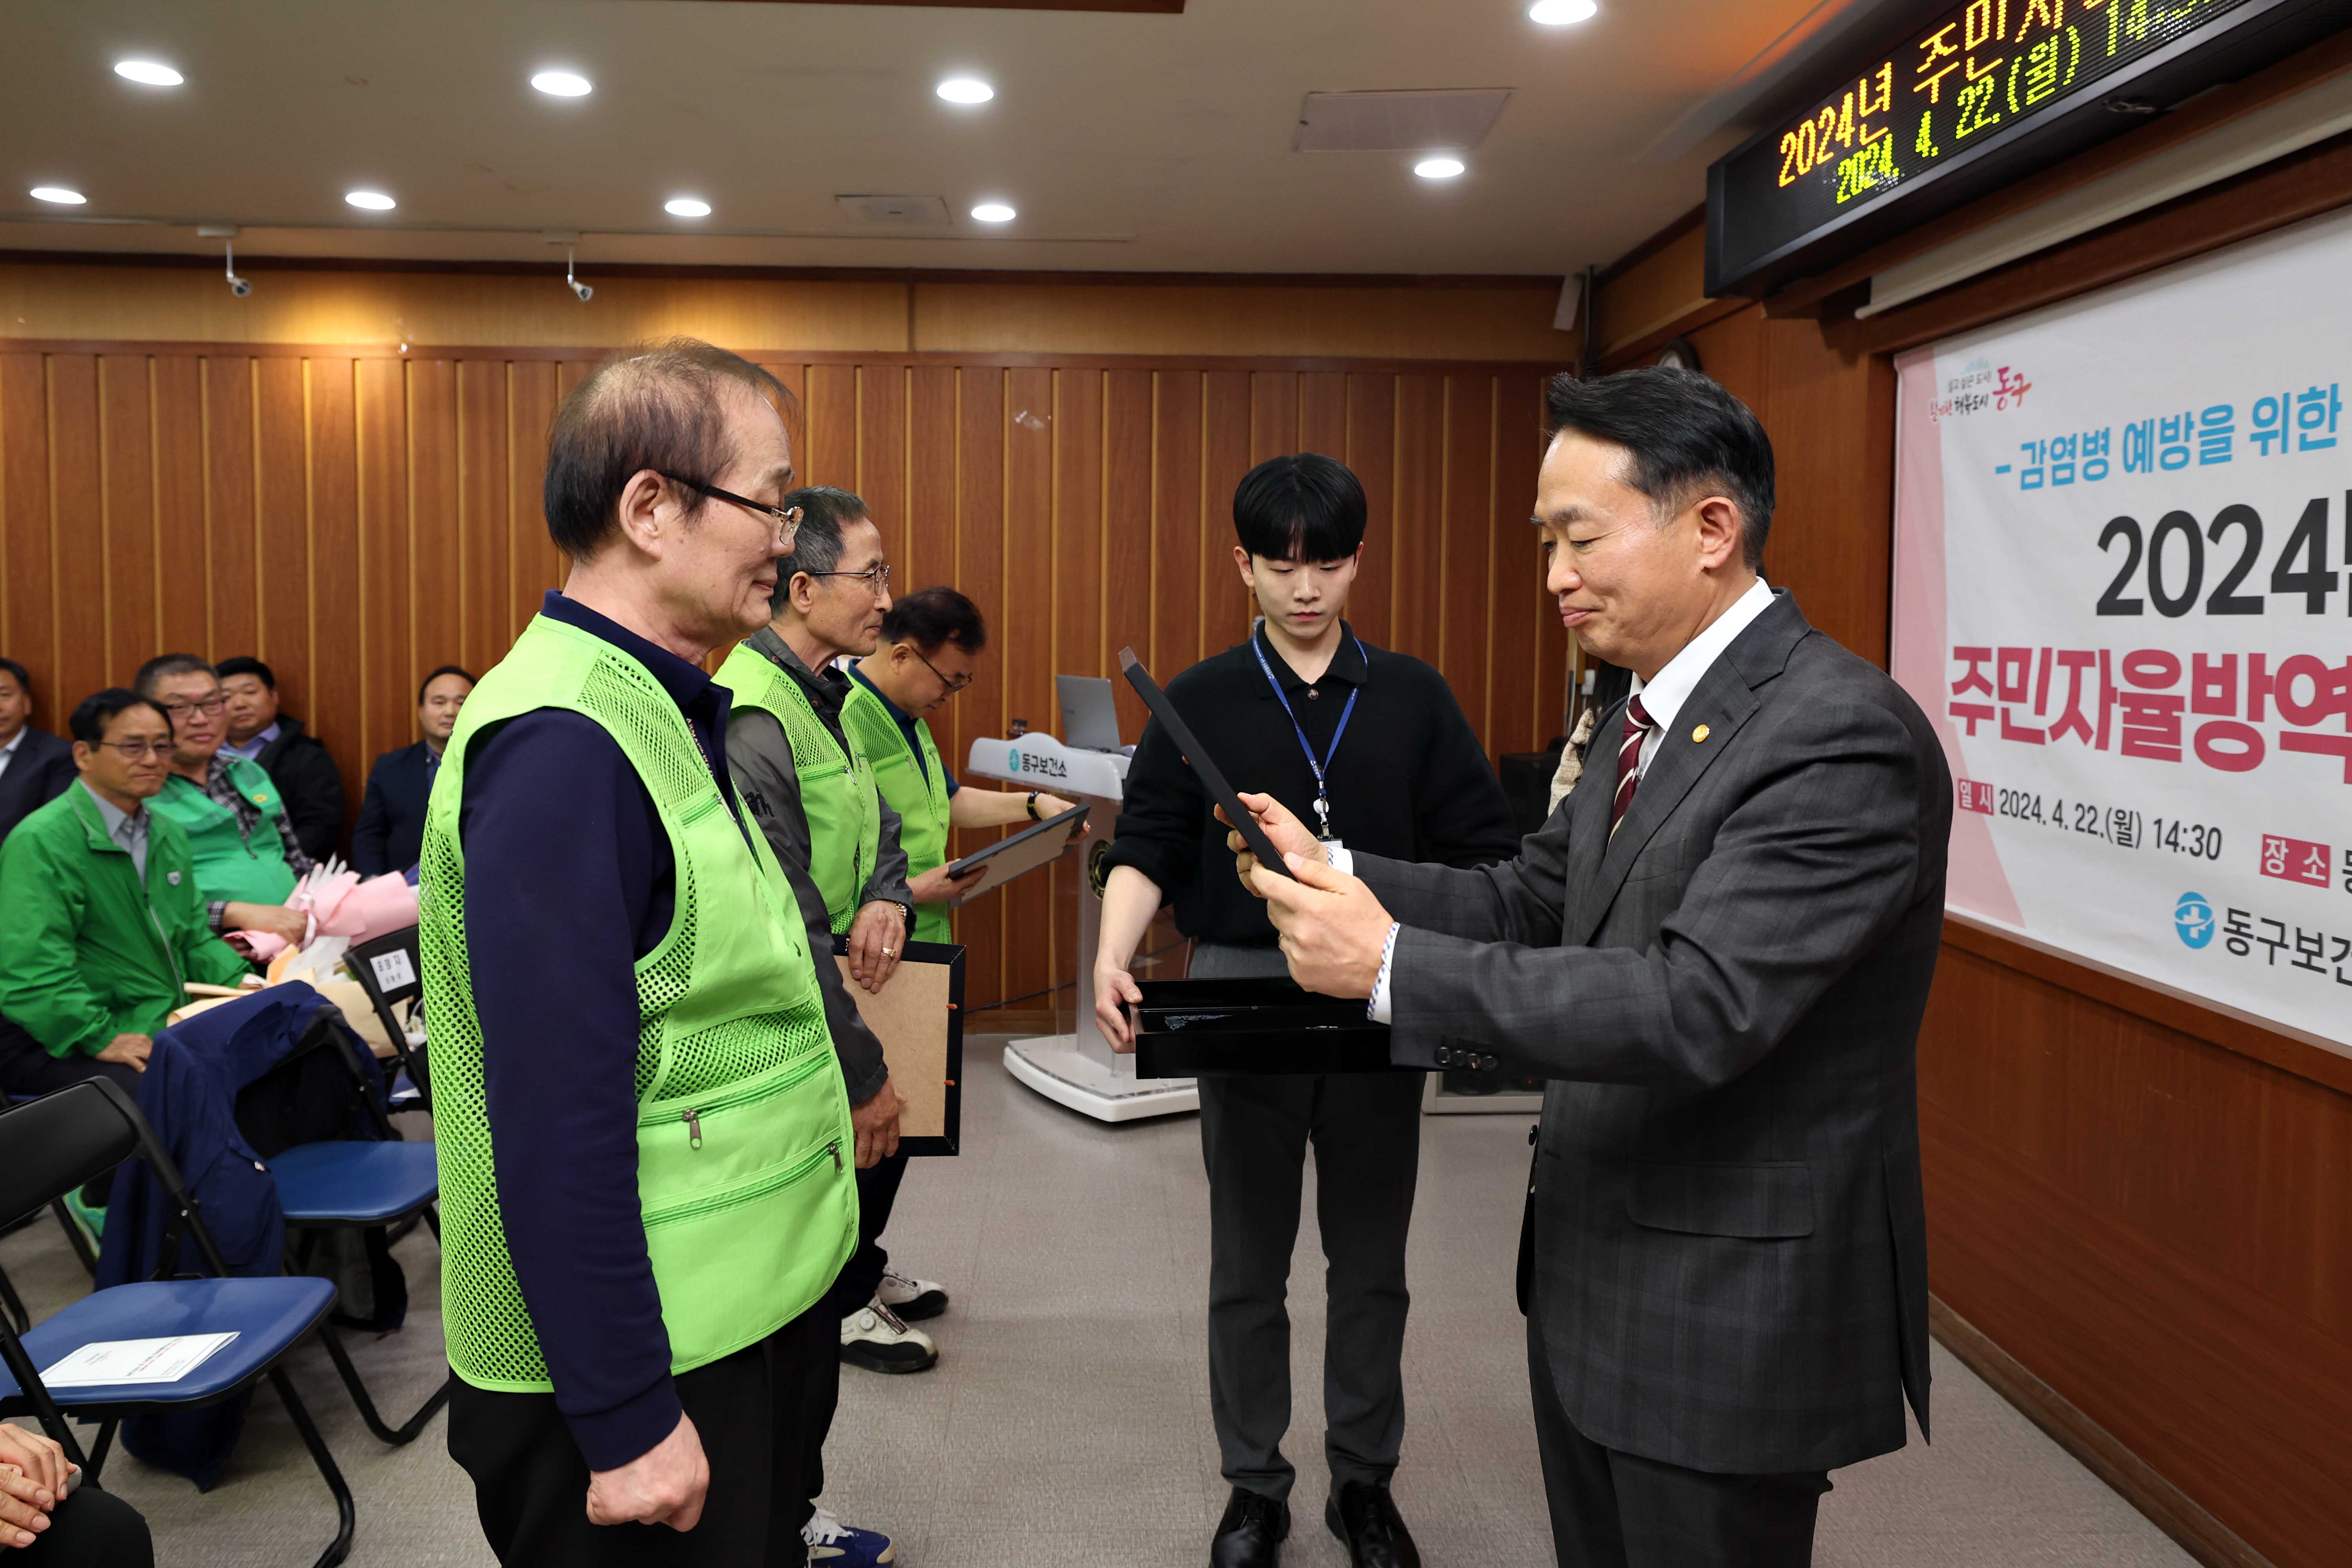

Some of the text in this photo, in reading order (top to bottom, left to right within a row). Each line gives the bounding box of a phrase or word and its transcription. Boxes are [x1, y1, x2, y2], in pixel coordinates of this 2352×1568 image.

[1779, 62, 1892, 187] 2024년
[1837, 133, 1899, 203] 2024.
[1915, 111, 1938, 157] 4.
[1993, 366, 2032, 411] 동구
[2123, 405, 2235, 473] 예방을
[2250, 383, 2342, 457] 위한
[2096, 489, 2352, 618] 2024
[1949, 646, 2352, 784] 주민자율방역
[1022, 753, 1067, 777] 동구보건소
[2000, 789, 2046, 825] 2024.
[2053, 799, 2068, 830] 4.
[2154, 818, 2222, 860] 14:30
